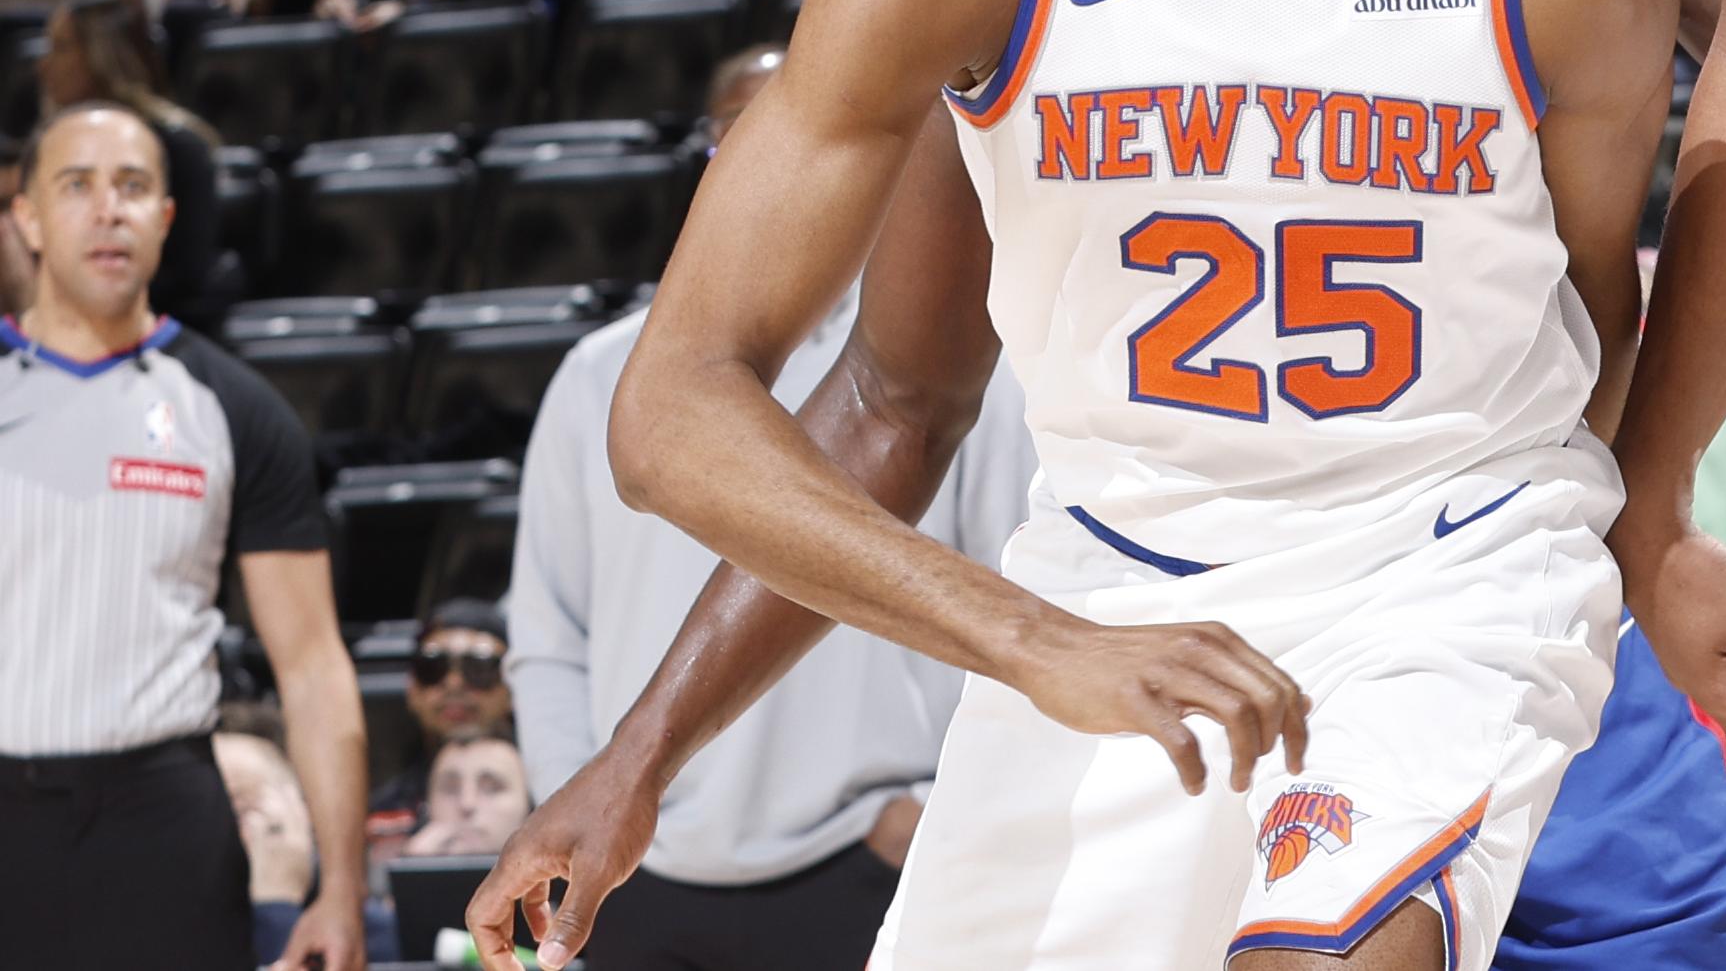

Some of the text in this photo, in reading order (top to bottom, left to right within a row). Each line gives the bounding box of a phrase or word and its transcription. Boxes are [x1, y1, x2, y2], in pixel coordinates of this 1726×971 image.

[1033, 83, 1504, 196] NEW YORK
[1120, 211, 1423, 423] 25
[111, 462, 204, 492] Emirates
